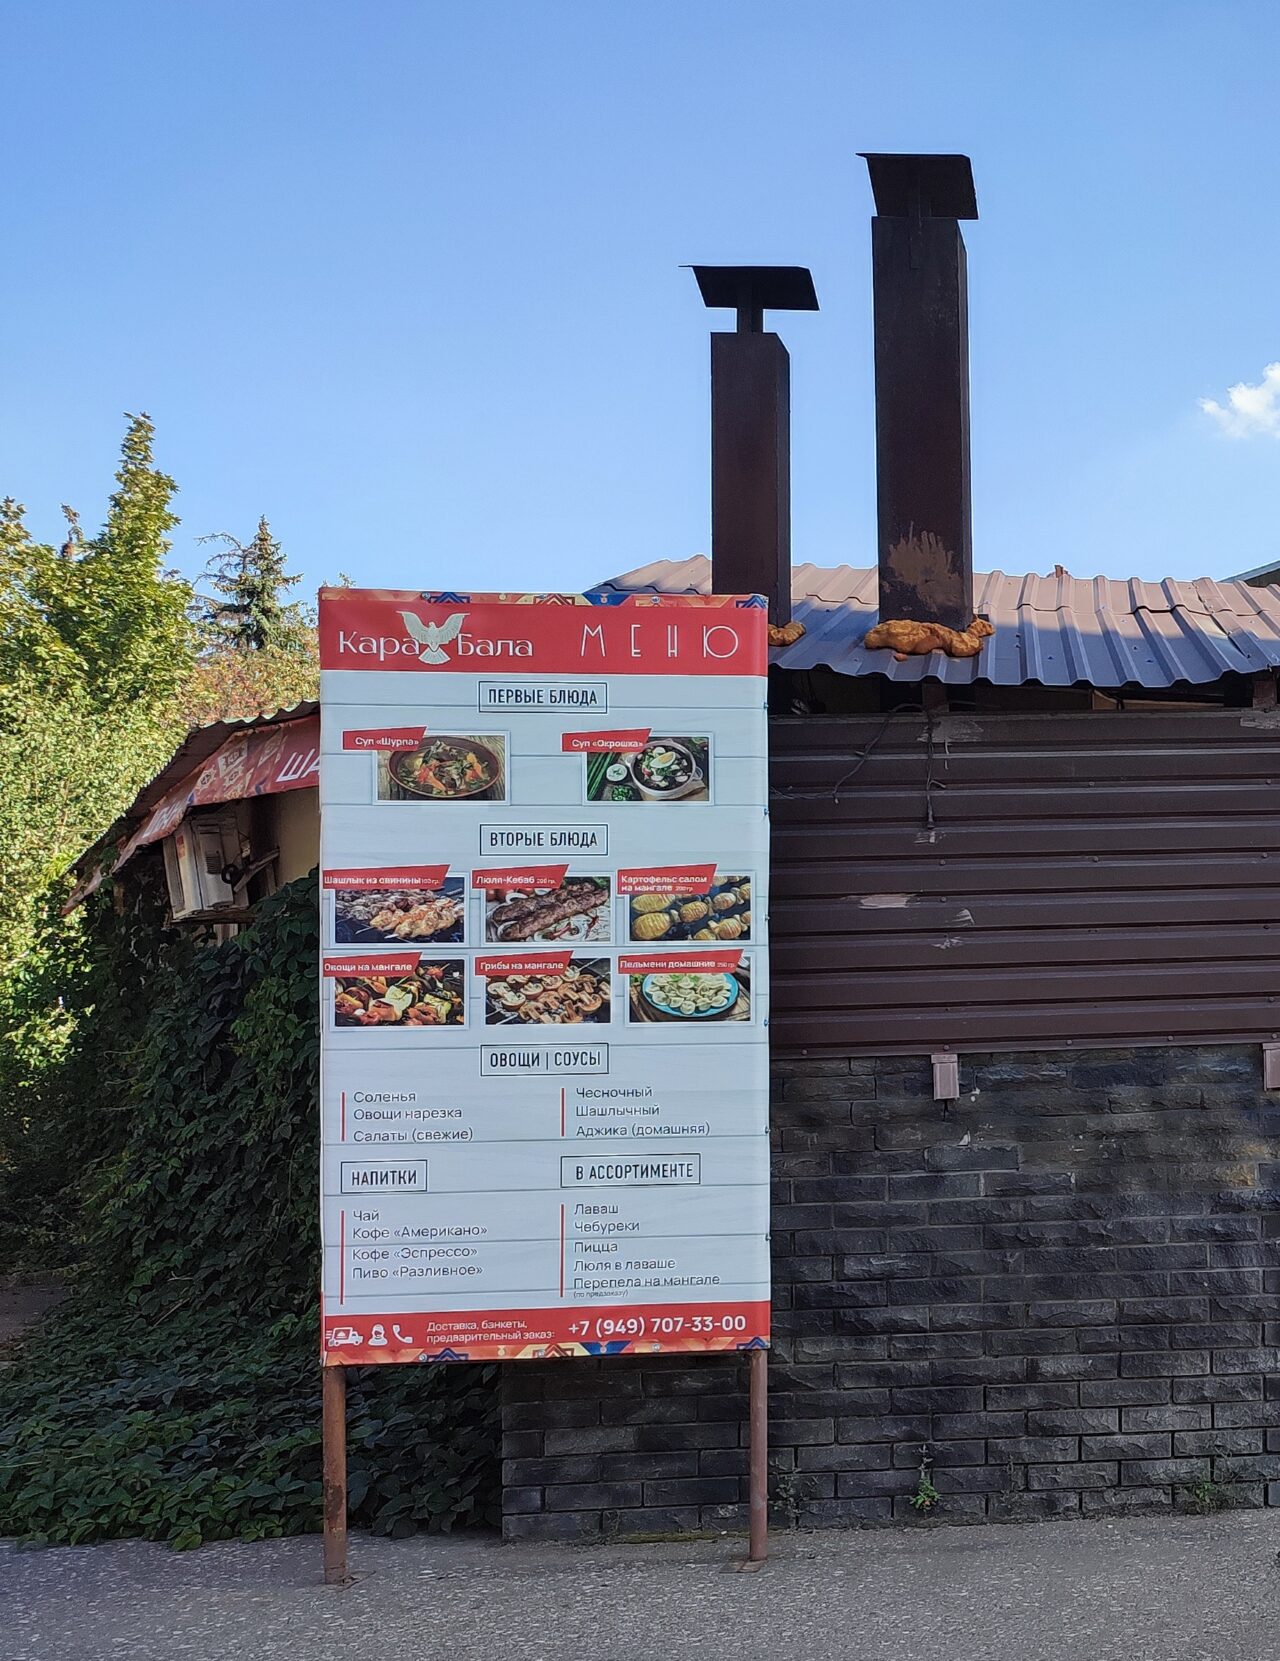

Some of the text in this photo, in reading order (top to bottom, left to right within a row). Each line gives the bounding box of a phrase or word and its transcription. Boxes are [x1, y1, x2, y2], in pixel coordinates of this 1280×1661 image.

[338, 630, 534, 662] Кара Бала
[580, 624, 739, 659] МЕНЮ
[488, 687, 598, 707] ПЕРВЫЕ БЛЮДА
[355, 737, 419, 747] Суп «Шурпа»
[572, 739, 590, 749] Суп
[490, 831, 598, 849] ВТОРЫЕ БЛЮДА
[324, 876, 365, 885] Шашлык
[379, 876, 421, 884] свинины
[324, 963, 356, 971] Овощи
[371, 963, 413, 971] мангале
[480, 961, 564, 971] Грибы на мангале
[620, 960, 667, 968] Пельмени
[668, 960, 716, 969] домашние
[490, 1050, 602, 1069] ОВОЩИ СОУСЫ
[353, 1091, 416, 1103] Соленья
[576, 1086, 653, 1099] Чесночный
[353, 1108, 462, 1121] Овощи нарезка
[576, 1104, 660, 1117] Шашлычный
[353, 1127, 473, 1142] Салаты (свежие)
[576, 1121, 710, 1138] Аджика (домашняя)
[351, 1169, 417, 1186] НАПИТКИ
[575, 1163, 694, 1181] В АССОРТИМЕНТЕ
[353, 1209, 380, 1222] Чай
[574, 1203, 619, 1215] Лаваш
[353, 1225, 488, 1241] Кофе «Американо»
[574, 1220, 640, 1234] Чебуреки
[353, 1247, 478, 1262] Кофе «Эспрессо»
[574, 1241, 618, 1254] Пицца
[352, 1265, 483, 1279] Пиво «Разливное»
[573, 1258, 676, 1272] Люля в лаваше
[573, 1274, 721, 1291] Перепела на мангале
[426, 1318, 528, 1332] Доставка, банкеты,
[568, 1315, 746, 1338] +7 (949) 707-33-00
[426, 1330, 555, 1344] предварительный заказ:
